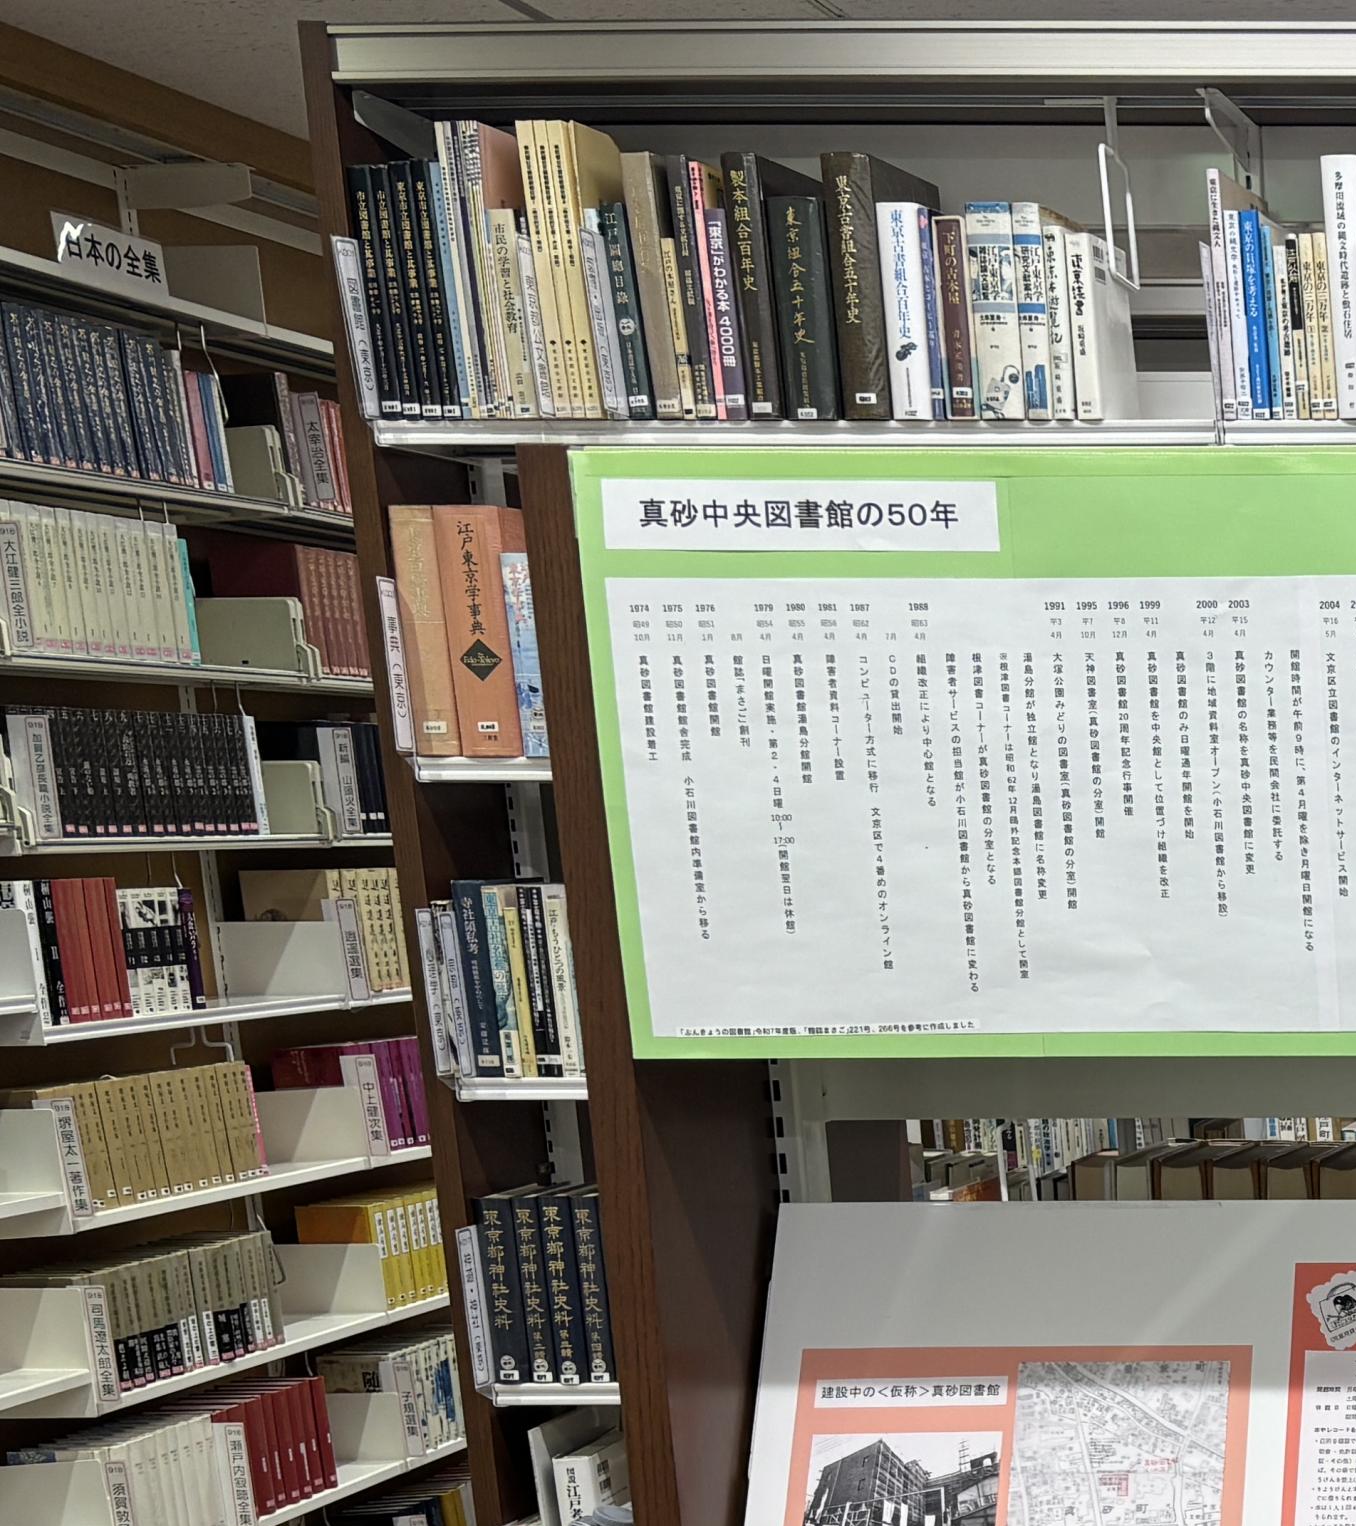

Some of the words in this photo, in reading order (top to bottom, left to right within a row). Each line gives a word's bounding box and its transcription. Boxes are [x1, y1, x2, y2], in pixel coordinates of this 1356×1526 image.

[729, 169, 759, 292] 製本組合百年史
[65, 233, 162, 284] 日本の全集
[890, 209, 912, 340] 東京古書組合百年史
[945, 231, 960, 305] 下町の古本屋
[1243, 219, 1260, 318] 東京の貝塚を考える
[718, 315, 737, 368] 4000冊
[305, 420, 330, 485] 太宰治全集
[638, 499, 959, 530] 真砂中央図書館の50年
[4, 540, 30, 642] 大江健三郎全小説
[456, 520, 487, 637] 江戸東京学事典
[629, 604, 650, 612] 1974
[662, 604, 683, 612] 1975
[695, 604, 716, 612] 1976
[754, 604, 773, 612] 1979
[786, 603, 806, 611] 1980
[818, 603, 838, 611] 1981
[850, 603, 870, 611] 1987
[909, 603, 929, 611] 1988
[1044, 601, 1066, 611] 1991
[1076, 601, 1098, 610] 1995
[1108, 601, 1130, 610] 1996
[1139, 601, 1161, 610] 1999
[1196, 600, 1218, 609] 2000
[1228, 600, 1250, 609] 2003
[1319, 601, 1341, 610] 2004
[704, 654, 721, 737] 真砂図書館開館
[362, 1079, 384, 1142] 中上健次集
[59, 1114, 89, 1214] 堺屋太一著作集
[482, 1210, 513, 1331] 東京都神社史料
[515, 1208, 544, 1329] 東京都神社史料
[542, 1206, 574, 1328] 東京都神社史料
[574, 1208, 605, 1329] 東京都神社史料
